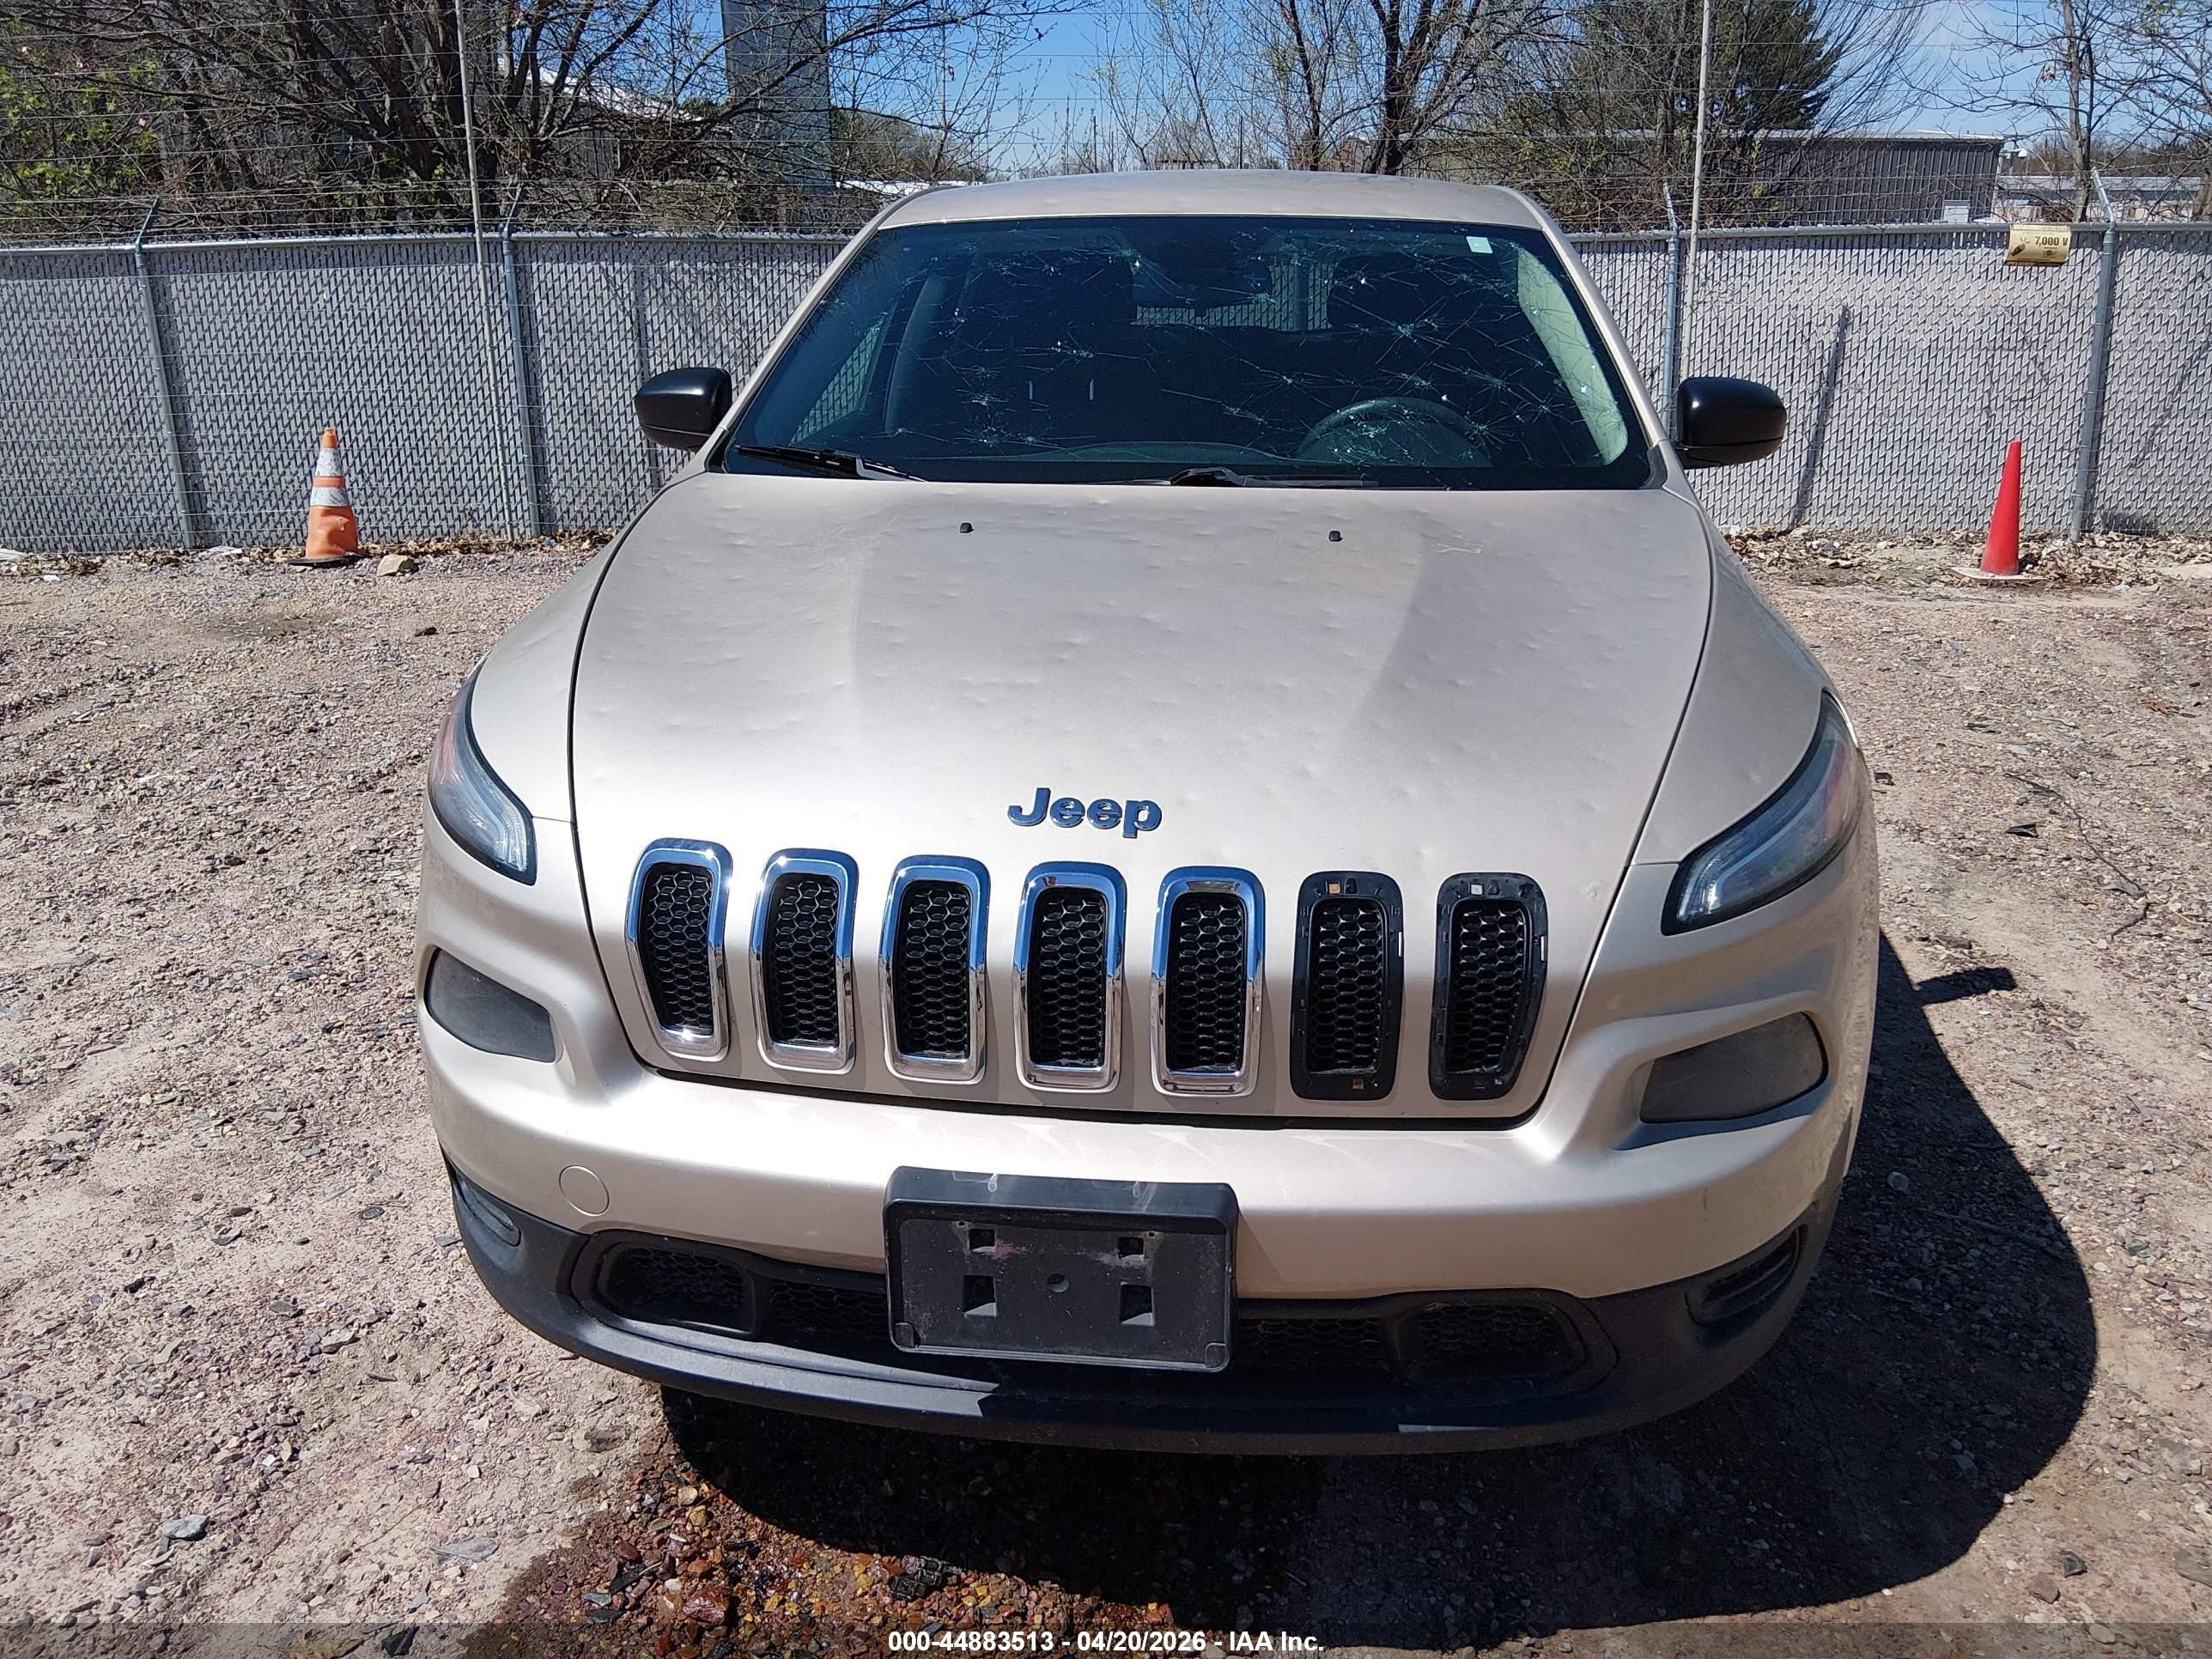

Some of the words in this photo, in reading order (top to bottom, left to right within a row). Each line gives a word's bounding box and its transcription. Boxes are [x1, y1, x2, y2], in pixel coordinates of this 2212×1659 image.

[2035, 236, 2059, 247] 7,000
[2063, 237, 2069, 246] V
[1007, 787, 1162, 839] Jeep
